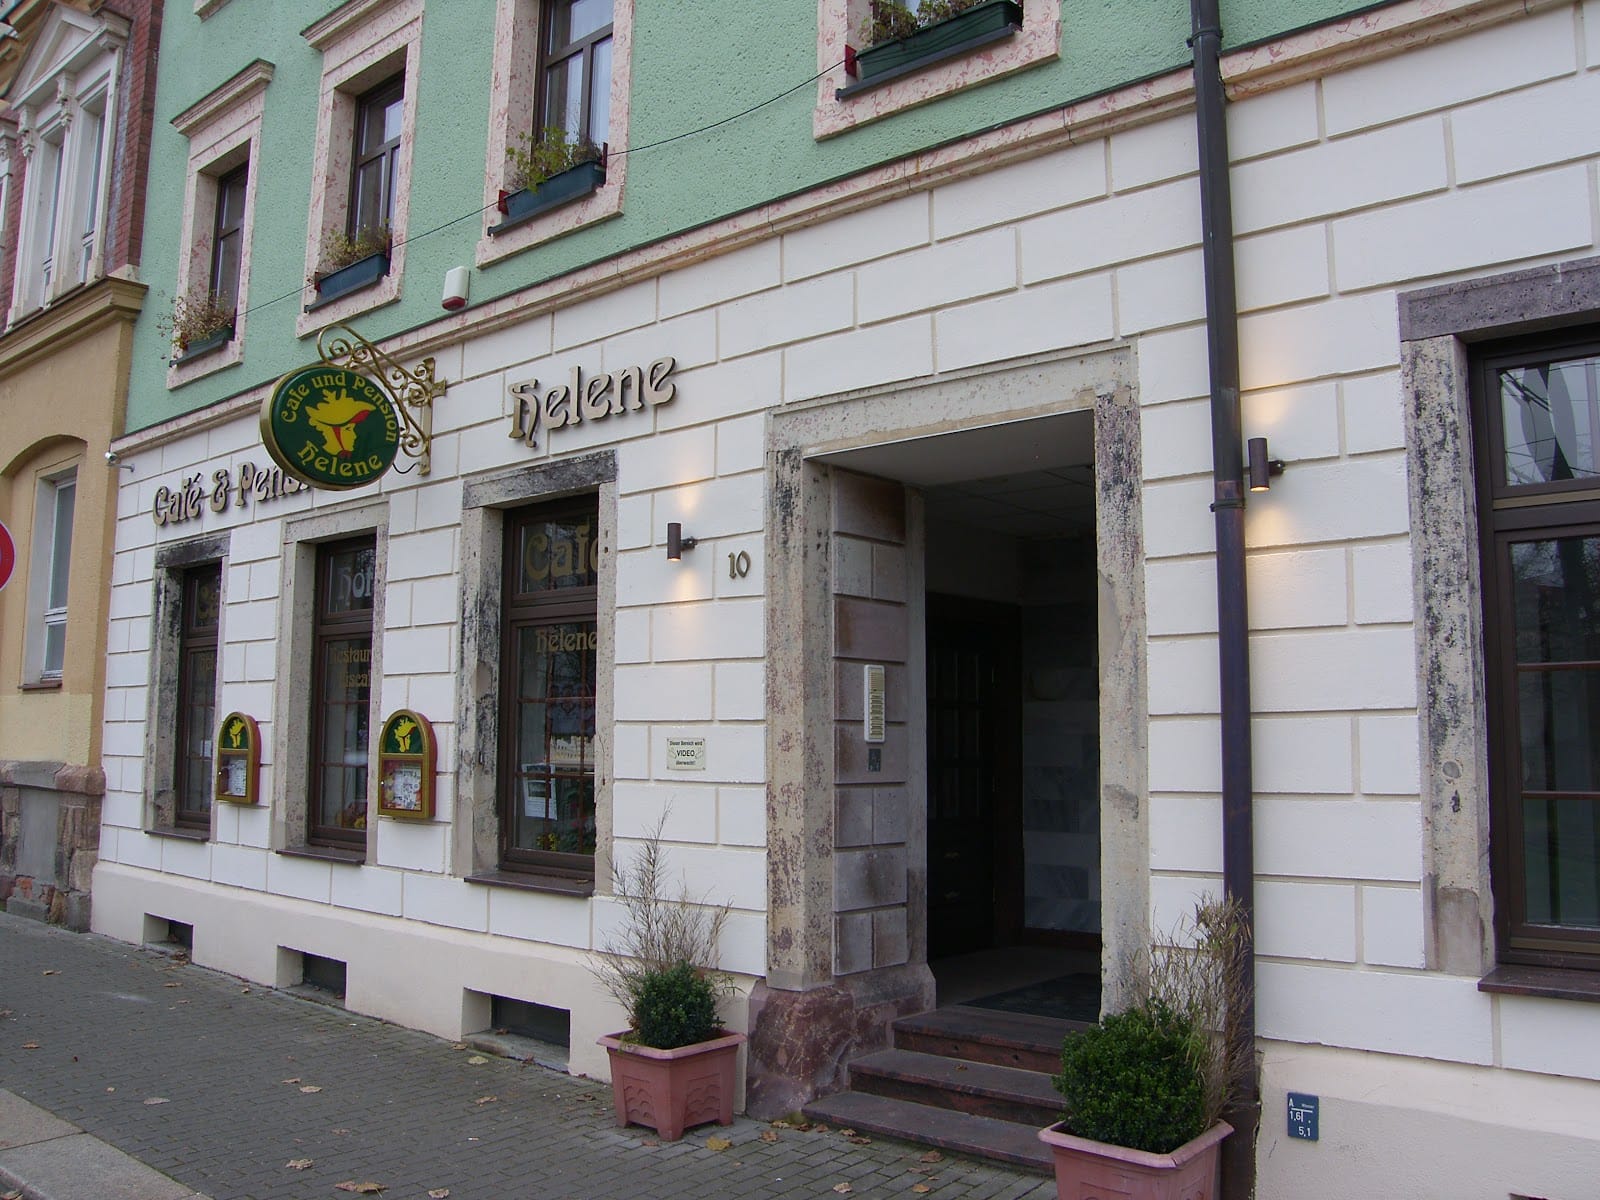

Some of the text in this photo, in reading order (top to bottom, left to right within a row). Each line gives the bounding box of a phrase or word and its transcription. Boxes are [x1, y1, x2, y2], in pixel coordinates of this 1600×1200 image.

[280, 372, 399, 443] Cafe und Pension
[508, 356, 677, 448] Helene
[297, 440, 383, 477] Helene
[153, 461, 312, 526] Café & Pens
[728, 550, 751, 579] 10
[677, 749, 695, 757] VIDEO
